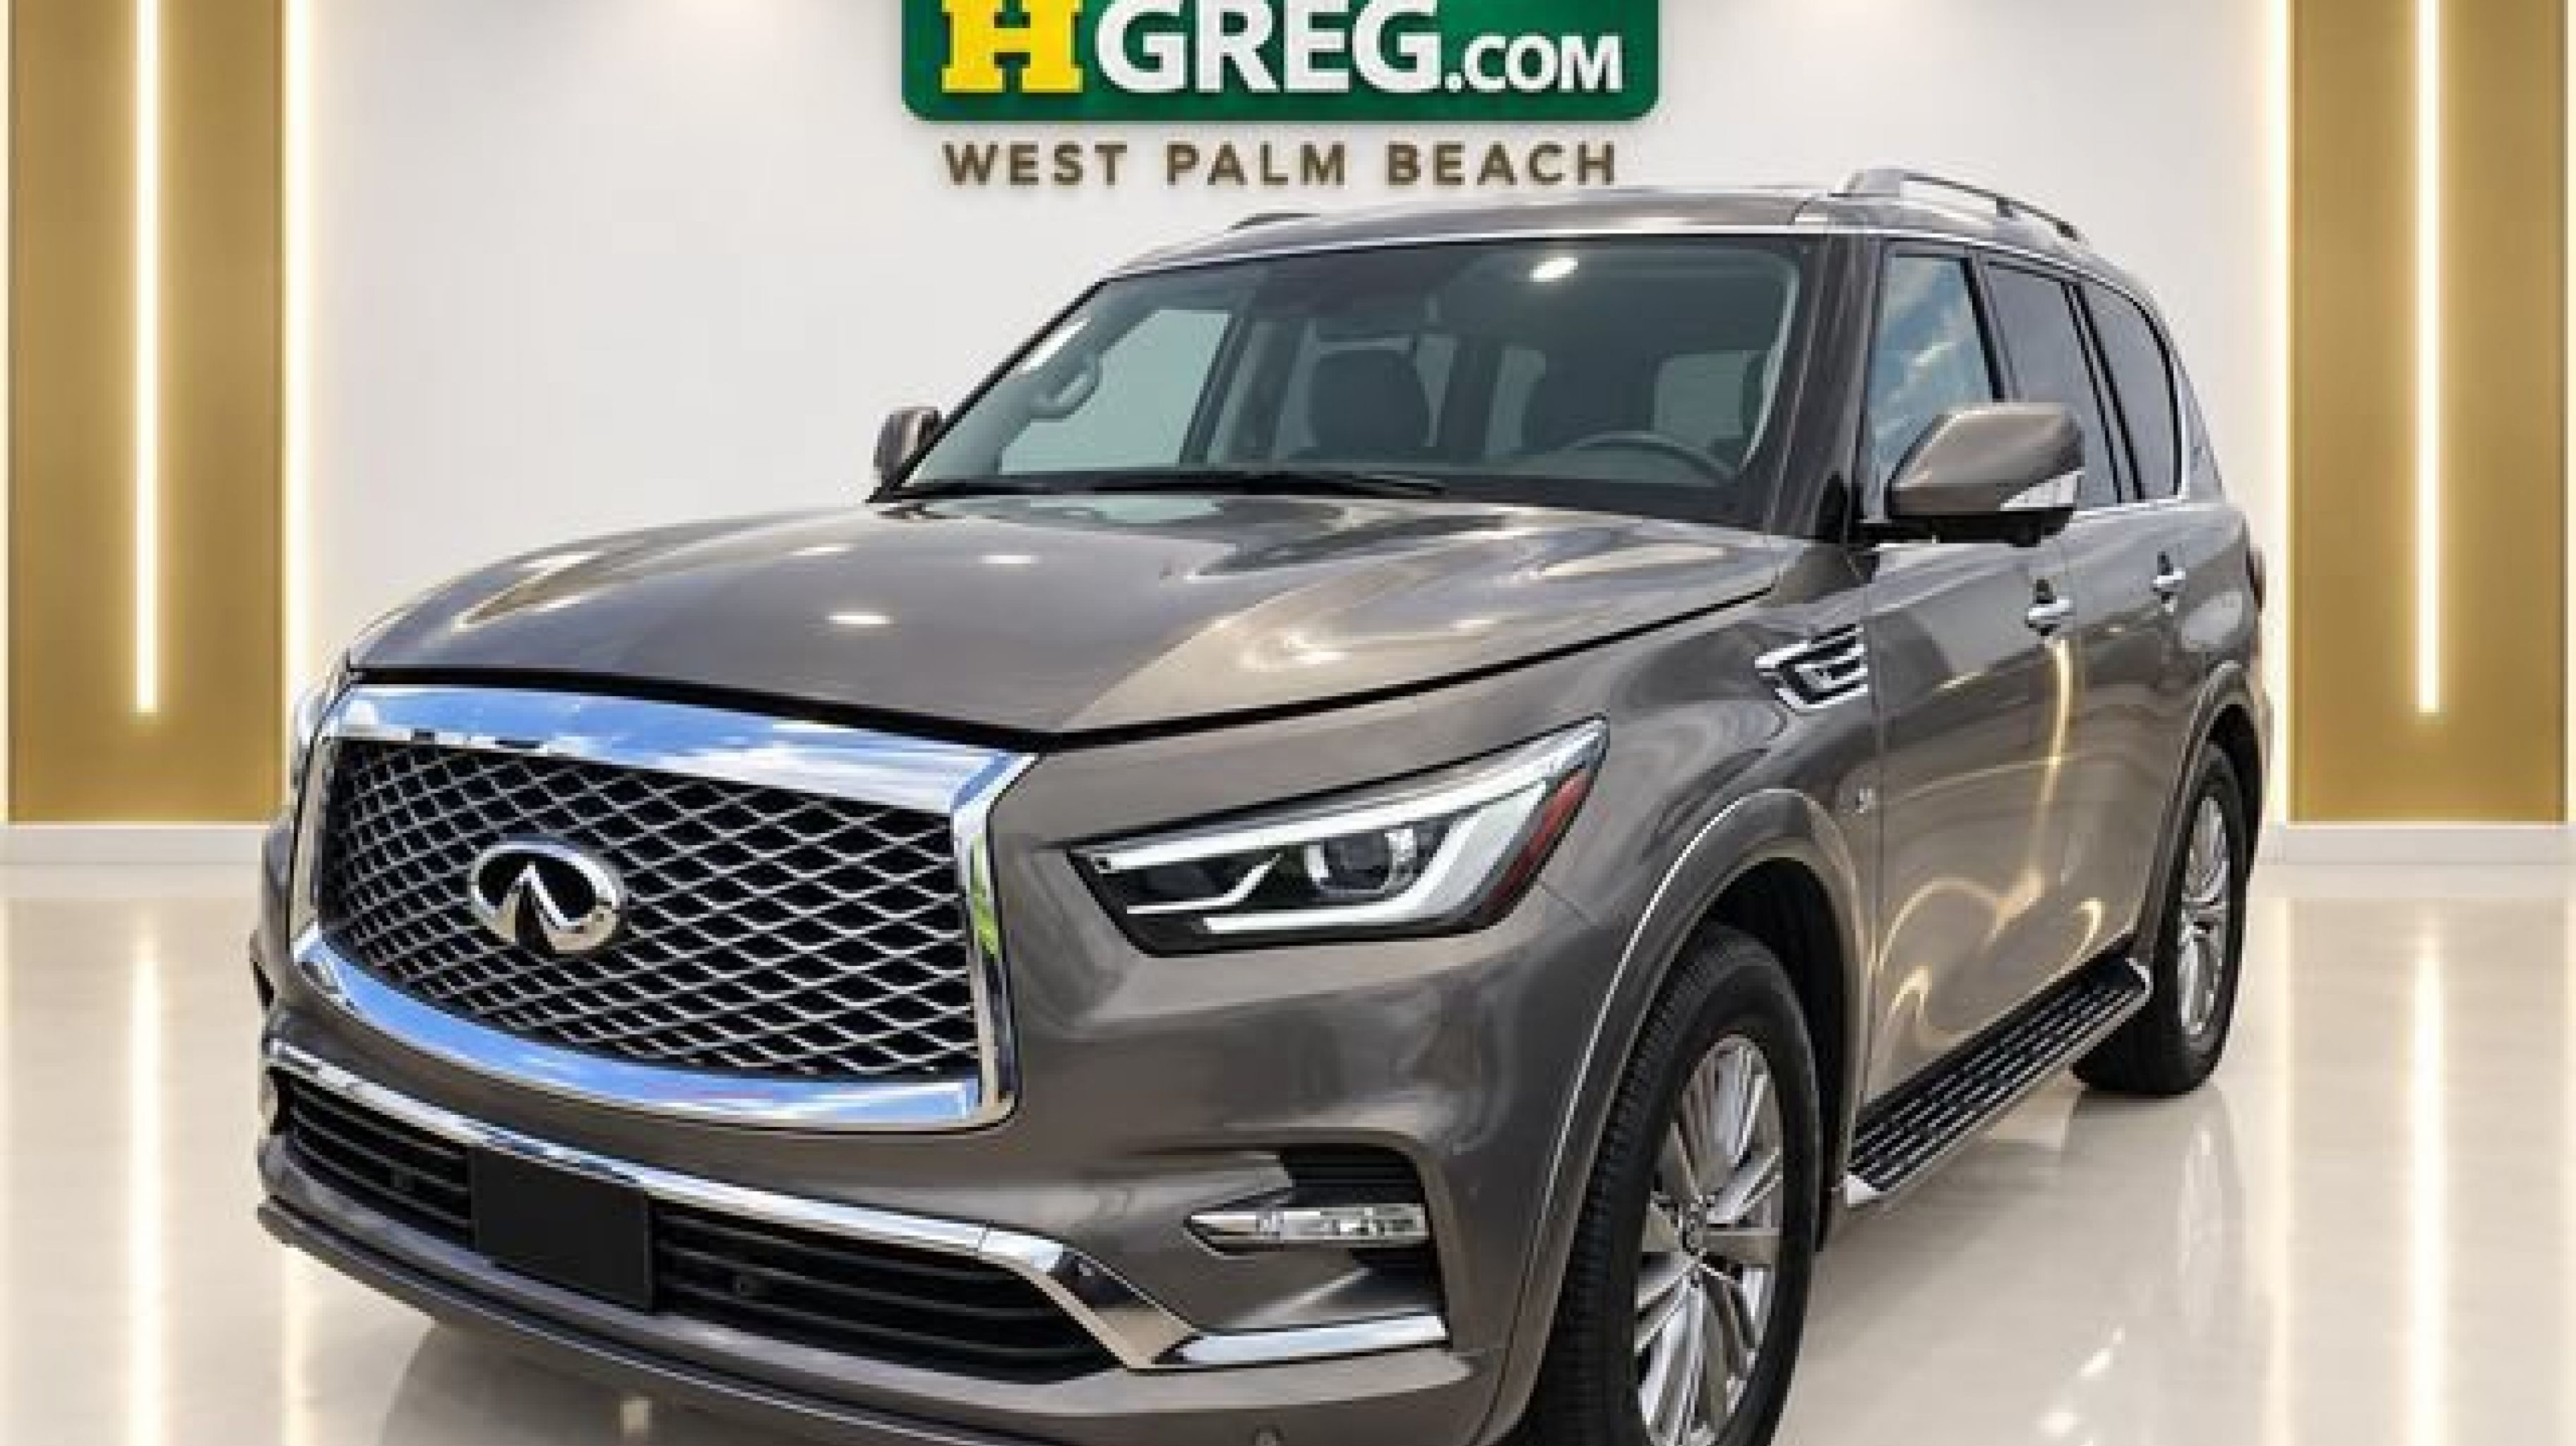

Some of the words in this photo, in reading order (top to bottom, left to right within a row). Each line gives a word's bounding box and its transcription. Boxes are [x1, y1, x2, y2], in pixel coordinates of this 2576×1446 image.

[941, 141, 1128, 186] WEST
[1165, 141, 1344, 186] PALM
[1385, 141, 1615, 186] BEACH
